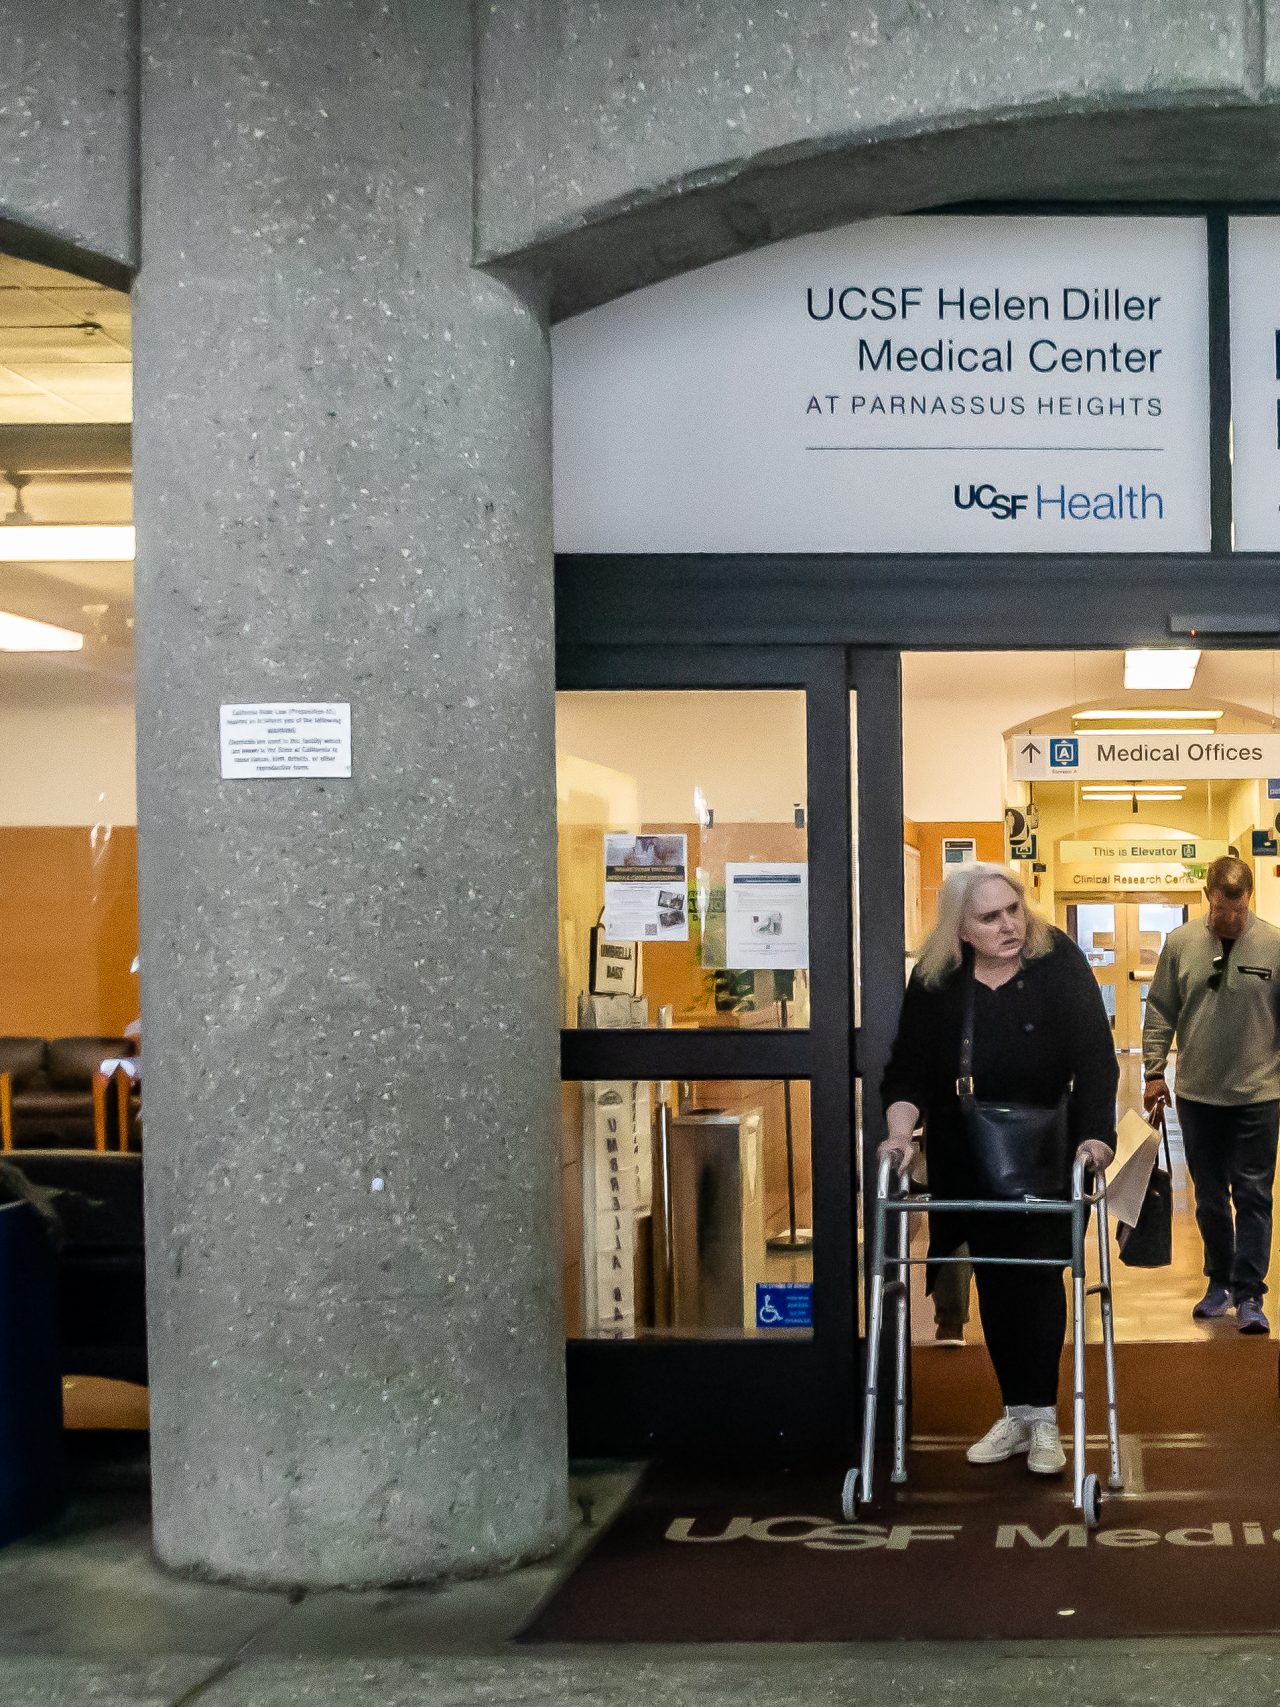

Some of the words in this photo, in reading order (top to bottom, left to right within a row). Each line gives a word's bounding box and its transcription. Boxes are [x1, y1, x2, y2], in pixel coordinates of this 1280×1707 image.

[806, 287, 923, 321] UCSF
[938, 287, 1050, 321] Helen
[1063, 288, 1162, 321] Diller
[858, 339, 1013, 374] Medical
[1028, 340, 1163, 374] Center
[806, 396, 840, 415] AT
[851, 396, 1026, 416] PARNASSUS
[1037, 397, 1163, 417] HEIGHTS
[954, 484, 1029, 520] UCSF
[1036, 484, 1165, 521] Health
[1058, 748, 1070, 759] A
[1097, 744, 1180, 762] Medical
[1187, 743, 1264, 762] Offices
[1093, 846, 1115, 857] This
[1119, 846, 1127, 857] is
[1131, 846, 1178, 857] Elevator
[1073, 874, 1111, 884] Clinical
[1113, 874, 1162, 884] Research
[664, 1515, 964, 1551] UCSF
